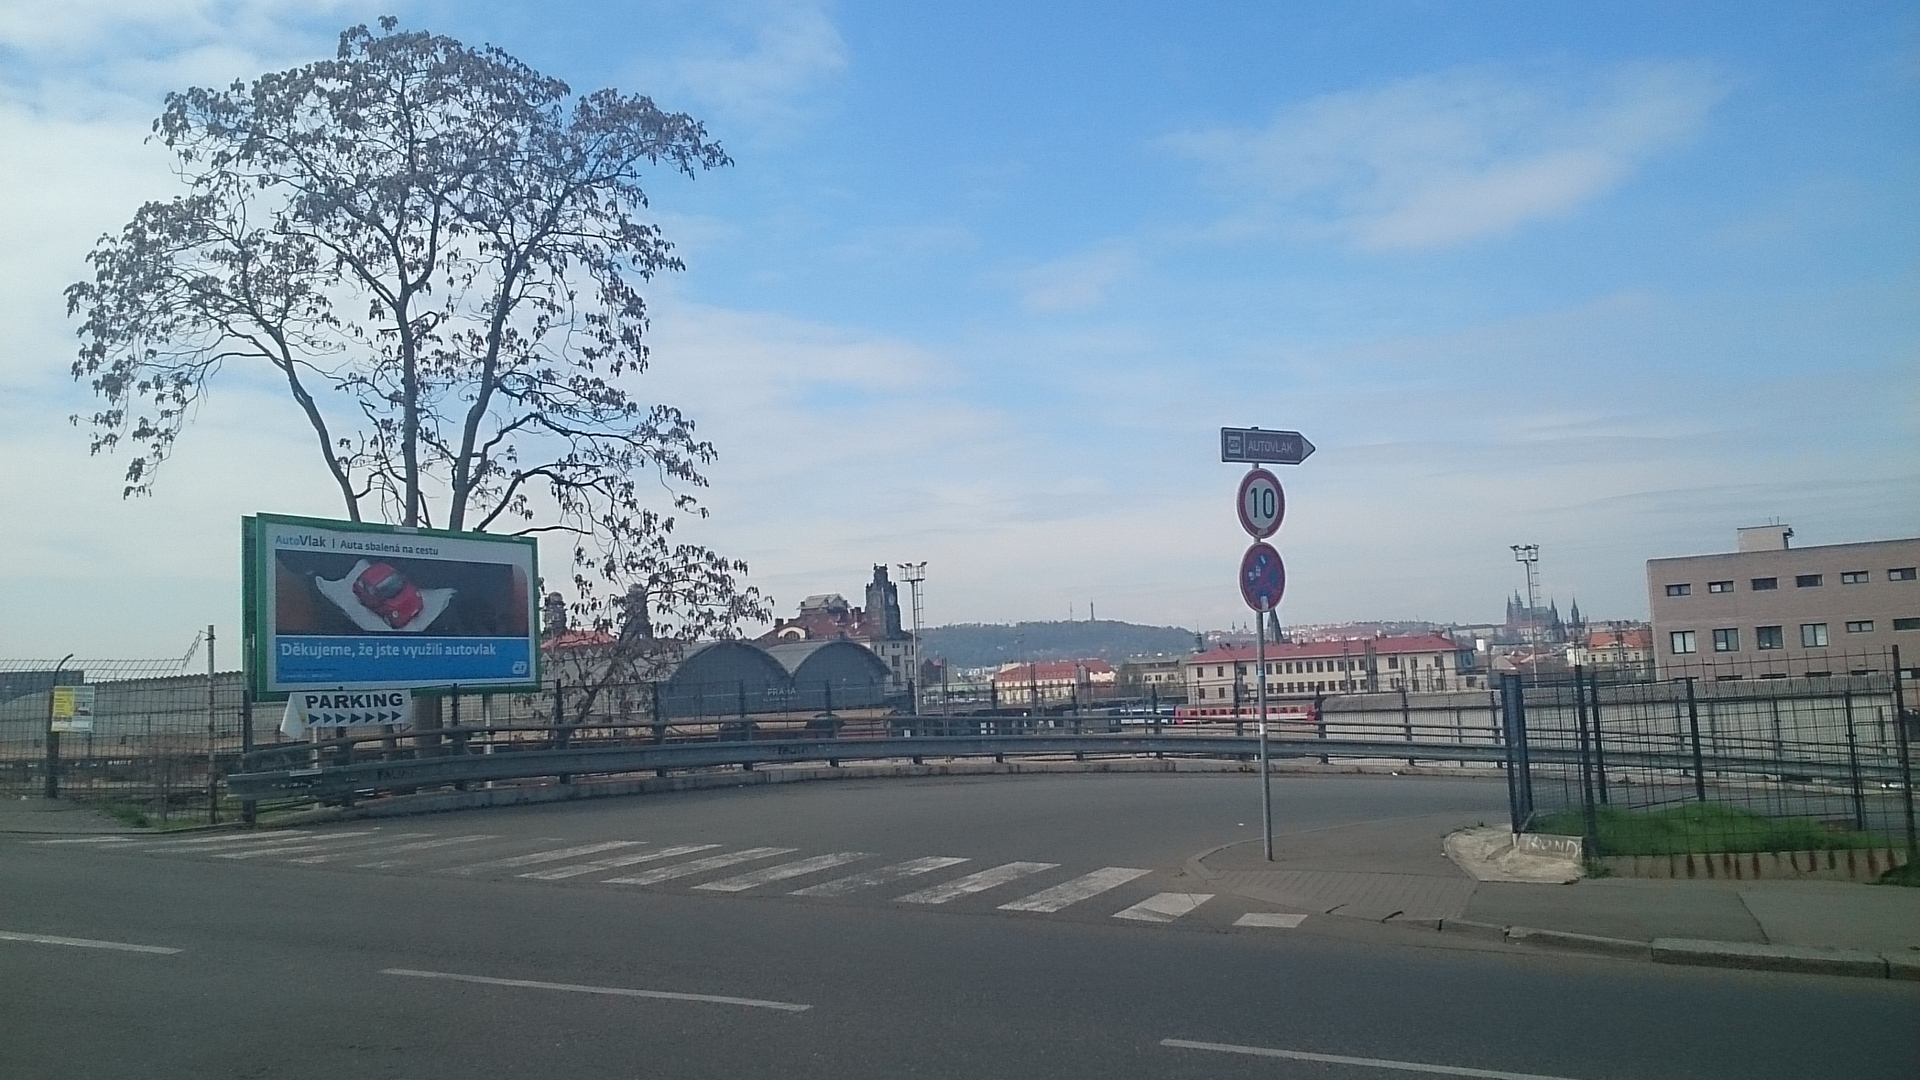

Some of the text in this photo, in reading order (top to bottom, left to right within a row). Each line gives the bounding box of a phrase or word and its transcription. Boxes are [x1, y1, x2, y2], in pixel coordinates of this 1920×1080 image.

[1248, 441, 1293, 453] AUTOVLAK
[1250, 487, 1275, 519] 10
[275, 535, 439, 556] AutoVlak Auta sbalená na cestu
[280, 642, 497, 660] Děkujeme, že jste využili autovlak
[305, 692, 404, 709] PARKING
